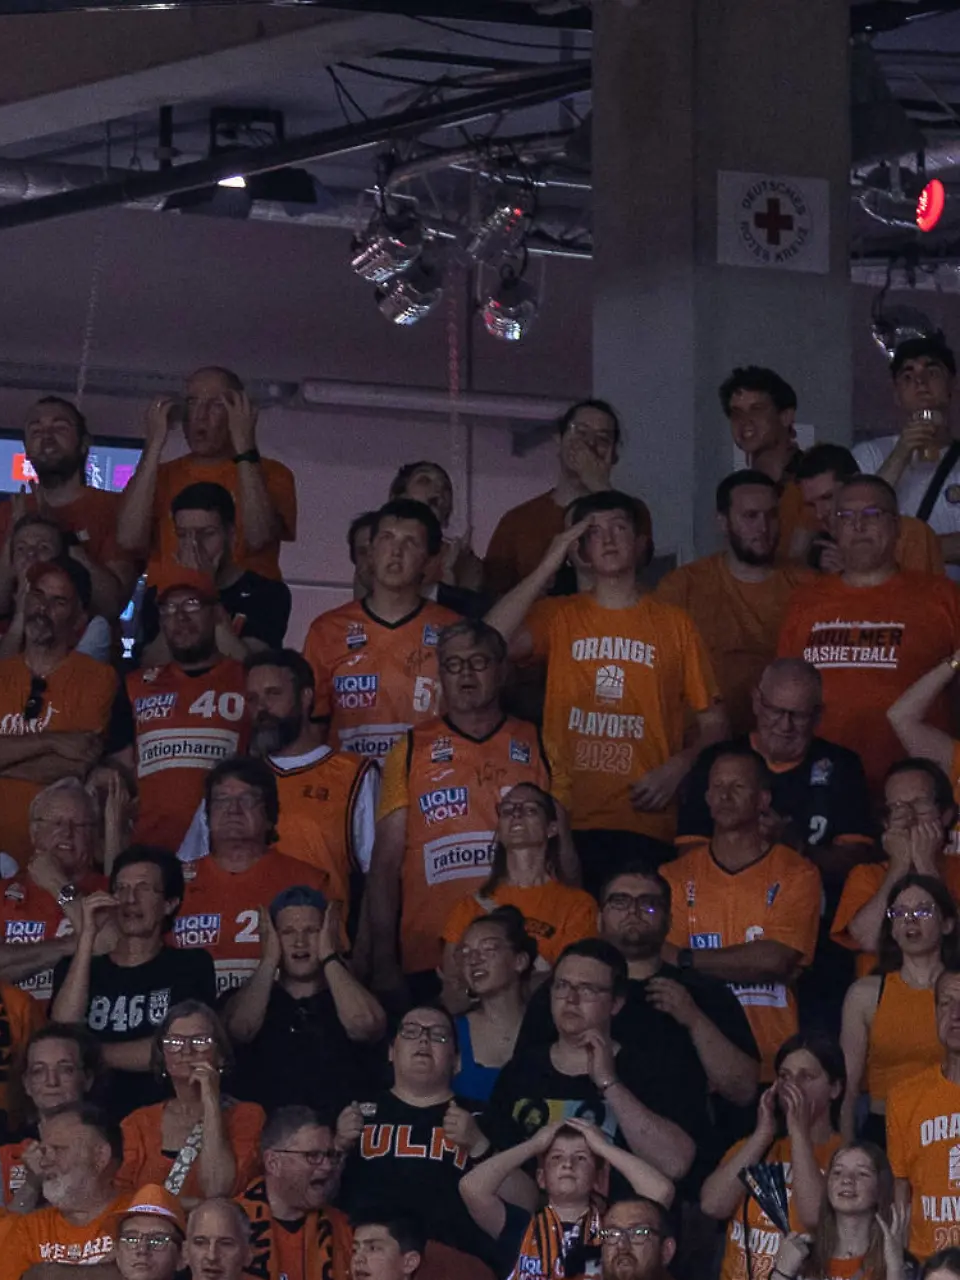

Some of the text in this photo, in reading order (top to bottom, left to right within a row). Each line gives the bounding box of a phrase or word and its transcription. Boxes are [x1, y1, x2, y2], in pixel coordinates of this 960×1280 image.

[741, 180, 806, 217] DEUTSCHES
[571, 636, 656, 668] ORANGE
[186, 689, 246, 721] 40
[568, 706, 645, 739] PLAYOFFS
[139, 739, 228, 766] ratiopharm
[573, 741, 633, 774] 2023
[420, 788, 467, 813] LIQUI
[174, 910, 259, 943] LIQUI 2
[88, 994, 146, 1032] 846
